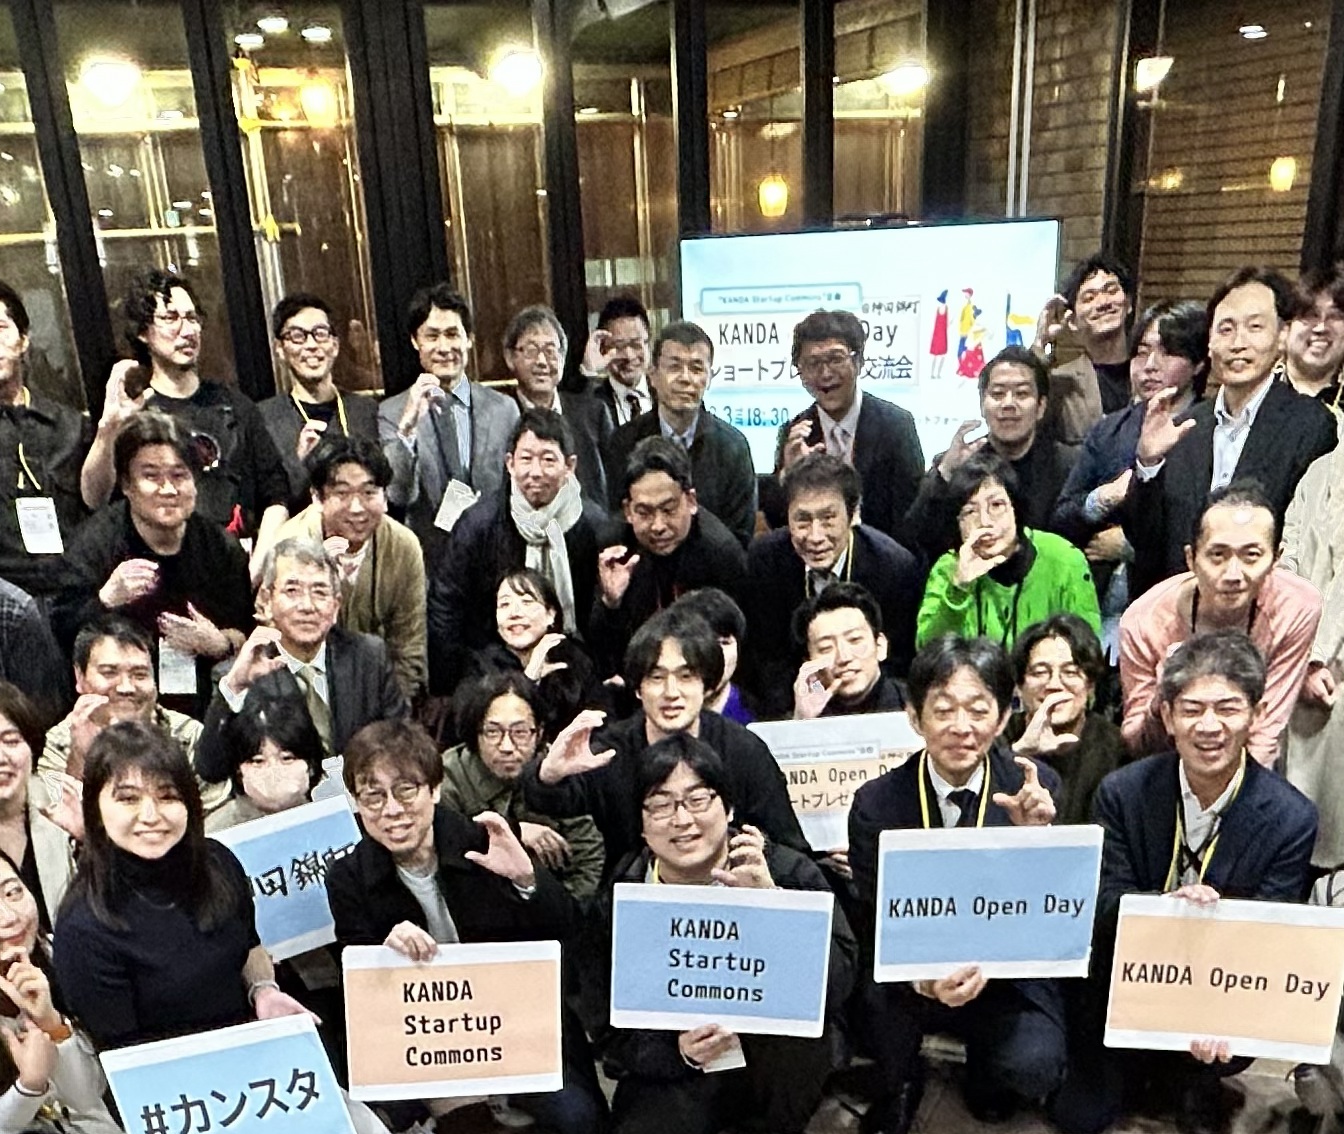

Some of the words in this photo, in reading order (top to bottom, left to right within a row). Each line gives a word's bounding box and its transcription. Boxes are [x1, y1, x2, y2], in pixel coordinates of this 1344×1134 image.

[719, 321, 780, 345] KANDA
[829, 767, 867, 785] Open
[889, 896, 957, 918] KANDA
[973, 895, 1027, 921] Open
[1044, 893, 1085, 918] Day
[670, 917, 739, 941] KANDA
[668, 948, 766, 977] Startup
[403, 979, 473, 1003] KANDA
[667, 978, 764, 1002] Commons
[1121, 961, 1193, 986] KANDA
[1209, 966, 1268, 993] Open
[1285, 973, 1331, 1002] Day
[404, 1012, 502, 1036] Startup
[406, 1046, 503, 1066] Commons
